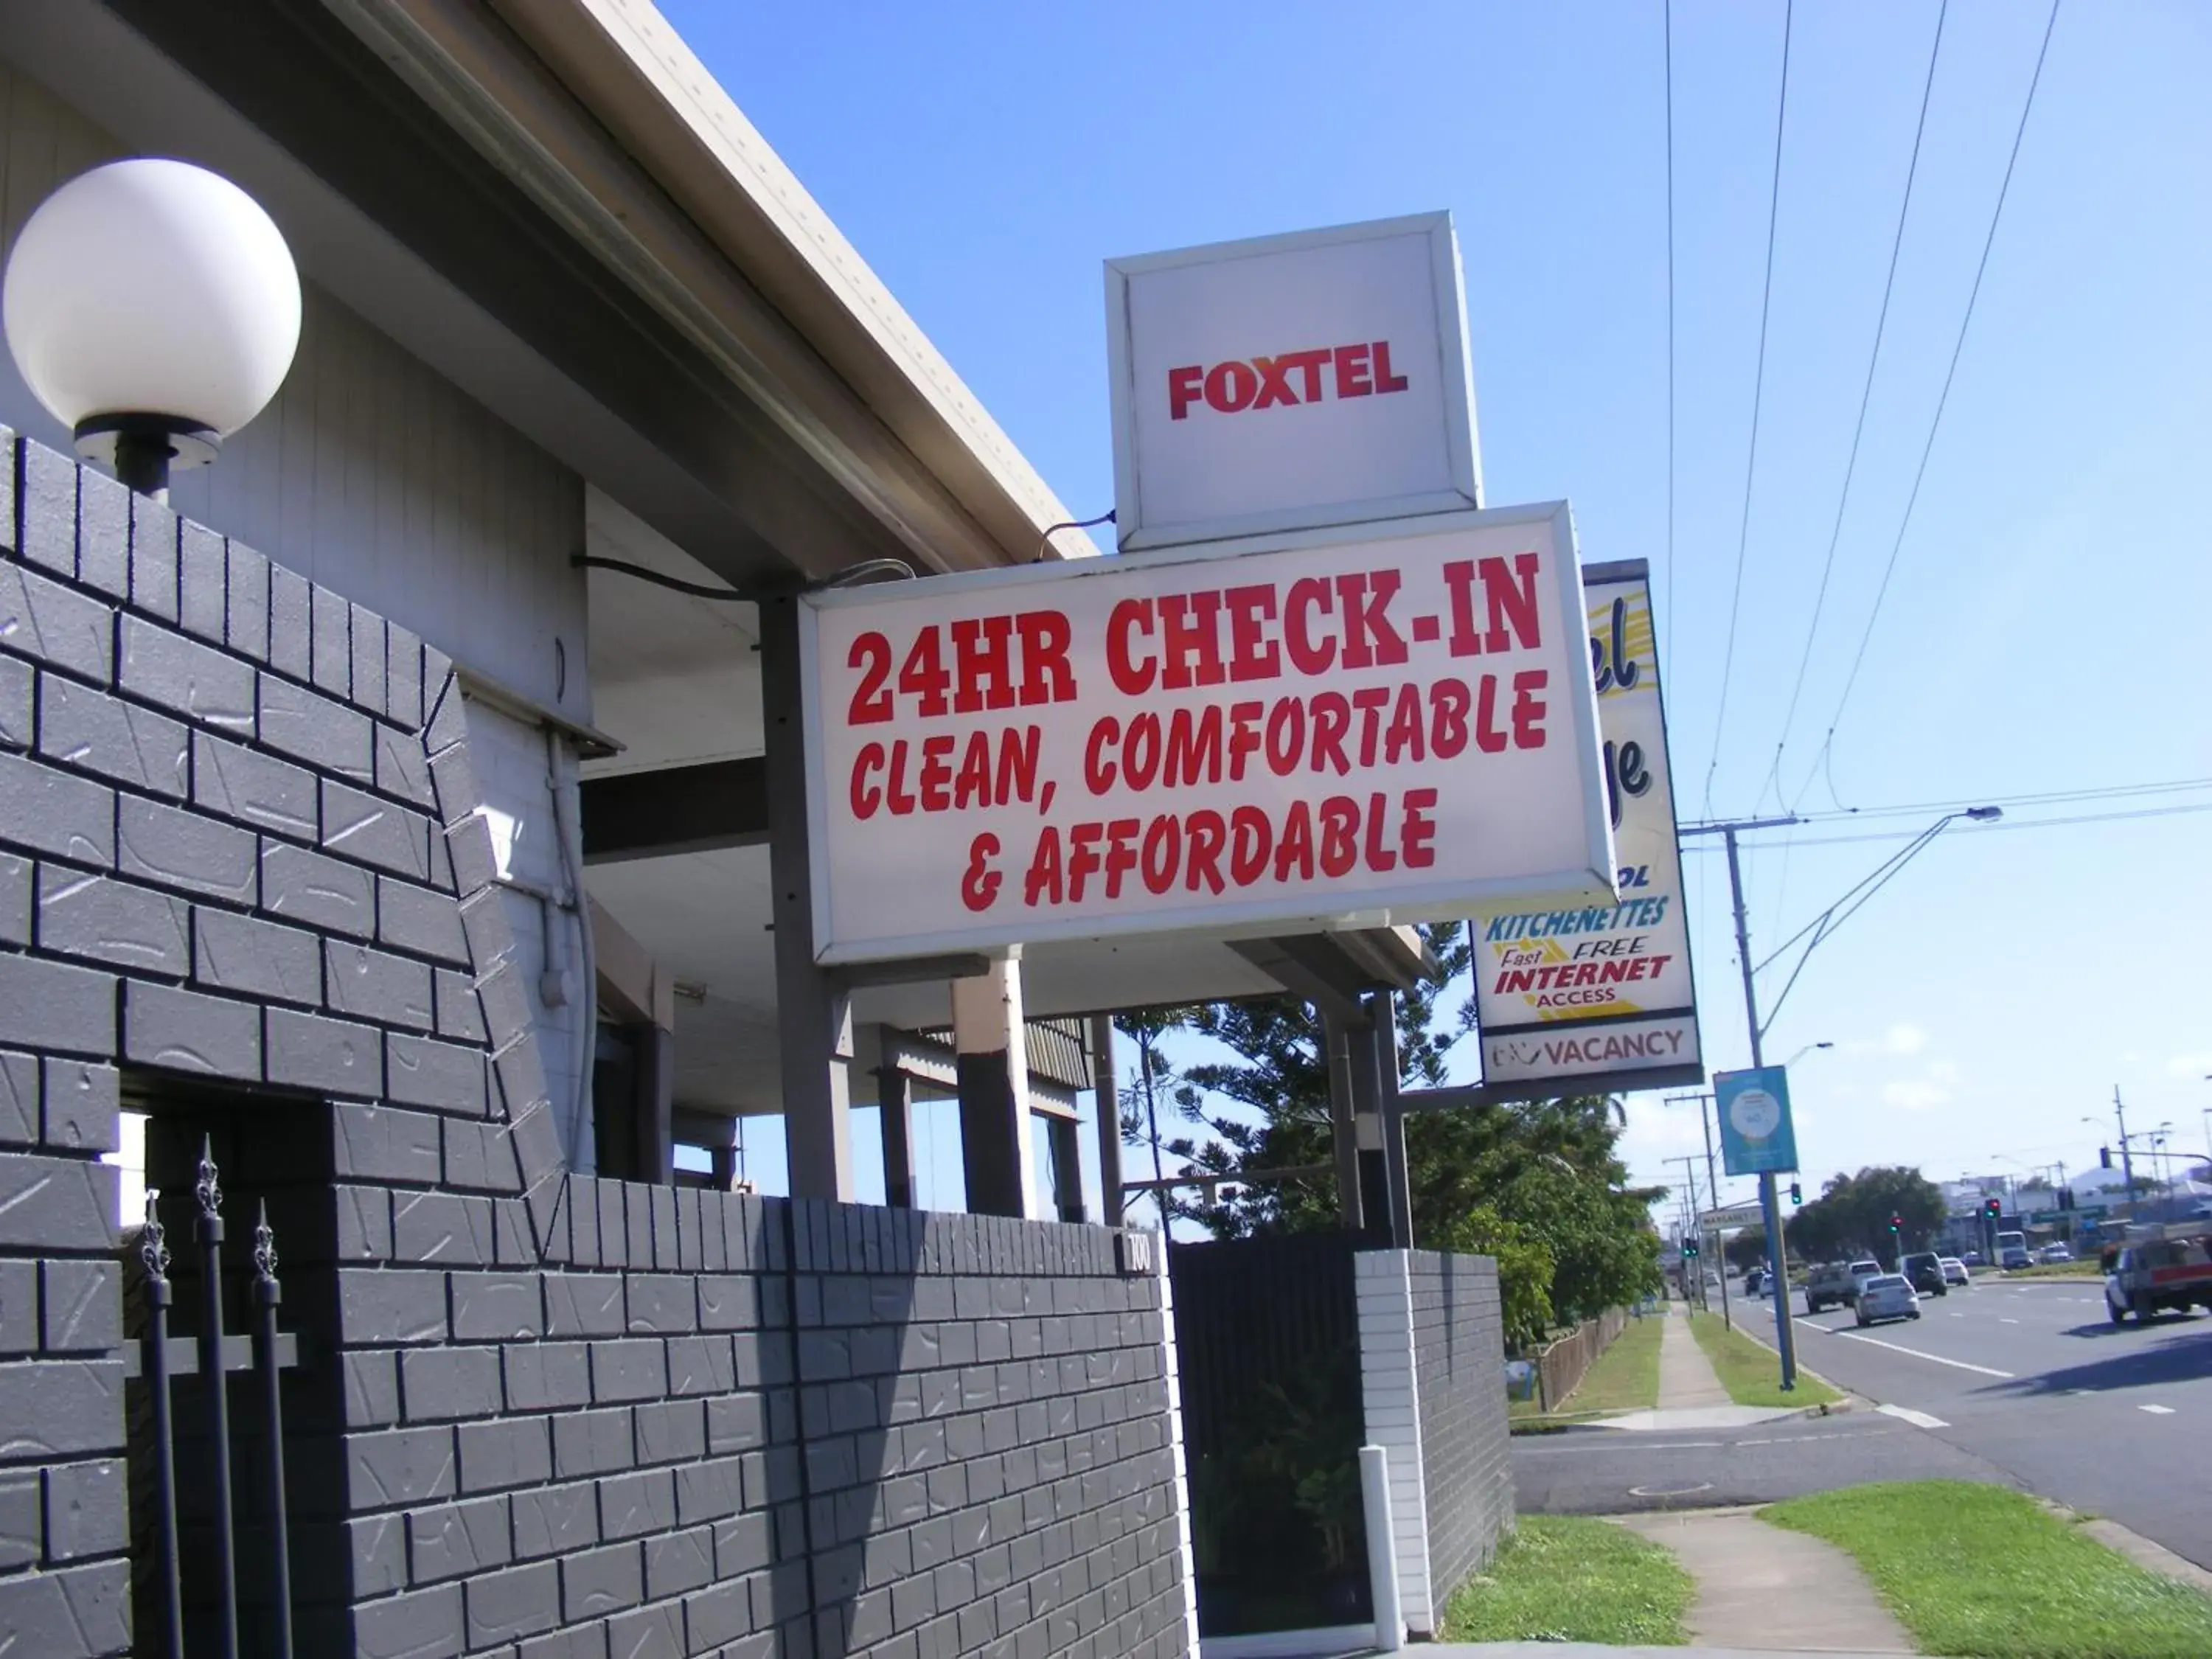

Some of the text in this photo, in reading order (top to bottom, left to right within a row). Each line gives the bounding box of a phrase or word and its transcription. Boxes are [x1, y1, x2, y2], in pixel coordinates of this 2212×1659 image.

[1168, 341, 1408, 420] FOXTEL
[848, 555, 1539, 726] 24HR CHECK-IN
[851, 670, 1546, 821] CLEAN, COMFORTABLE
[962, 789, 1437, 911] & AFFORDABLE
[1485, 895, 1669, 942] KITCHENETTES
[1494, 955, 1673, 995] INTERNET
[1500, 936, 1650, 968] Fast FREE
[1536, 988, 1616, 1008] ACCESS
[1544, 1029, 1683, 1065] VACANCY
